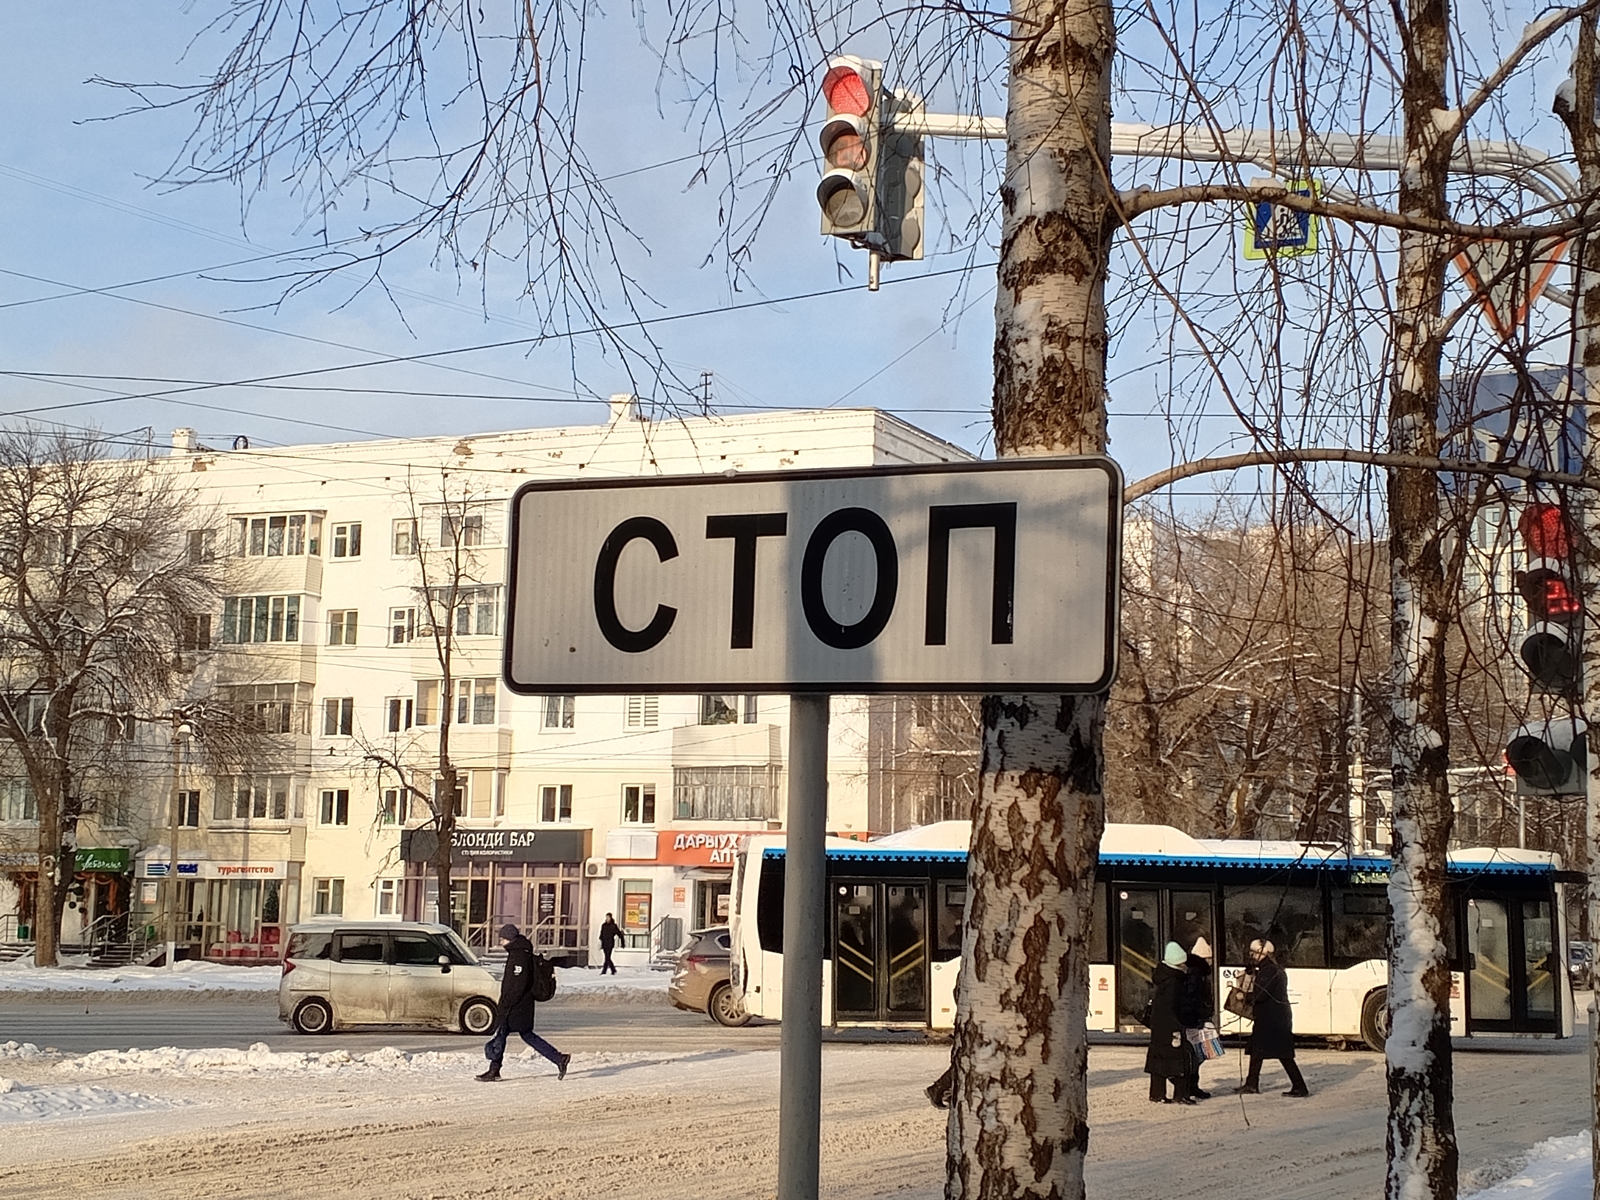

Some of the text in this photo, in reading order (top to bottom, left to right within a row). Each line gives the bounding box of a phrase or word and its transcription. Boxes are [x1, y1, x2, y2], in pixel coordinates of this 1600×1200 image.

[594, 502, 1017, 652] СТОП
[509, 831, 536, 847] БАР
[217, 866, 274, 875] турагентство
